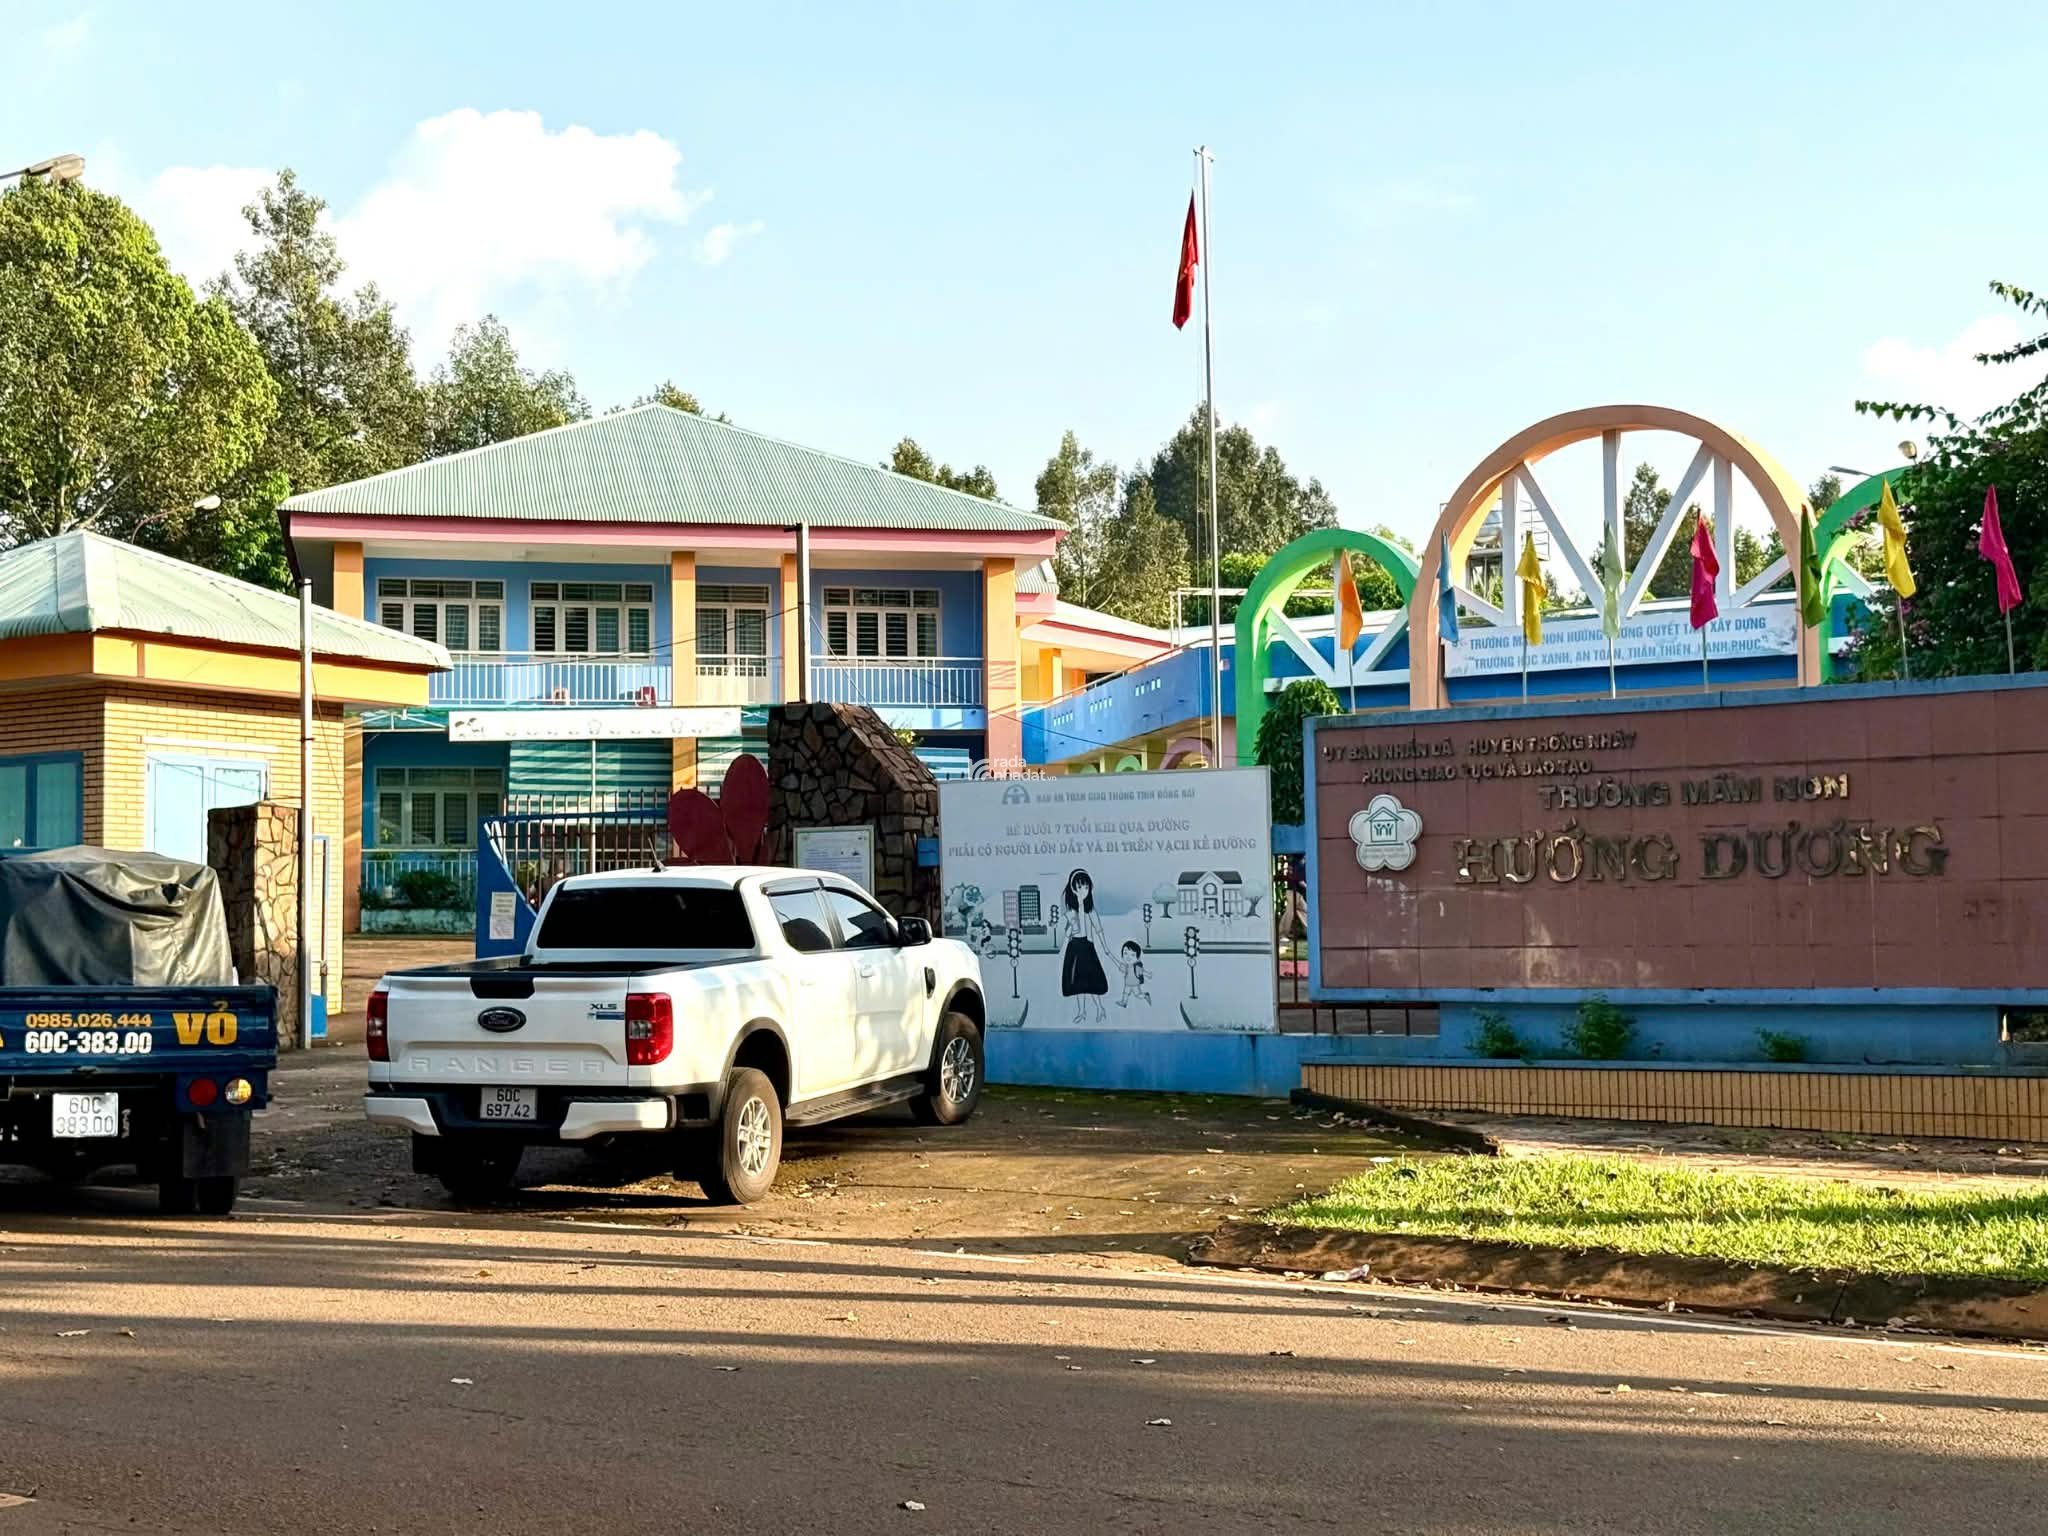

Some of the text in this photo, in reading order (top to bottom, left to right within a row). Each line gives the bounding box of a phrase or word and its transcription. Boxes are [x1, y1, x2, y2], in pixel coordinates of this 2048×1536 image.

[1537, 775, 1671, 809] TRƯỜNG
[1774, 773, 1849, 802] NON
[1453, 816, 1949, 884] HƯỚNG DƯƠNG
[590, 1002, 617, 1010] XLS
[26, 1013, 152, 1029] 0985.026.444
[173, 1000, 238, 1046] VỎ
[25, 1031, 153, 1054] 60C-383.00
[407, 1056, 606, 1074] RANGER
[496, 1088, 520, 1102] 60C
[69, 1097, 101, 1114] 60C
[485, 1103, 530, 1118] 697.42
[55, 1115, 115, 1135] 383.00
